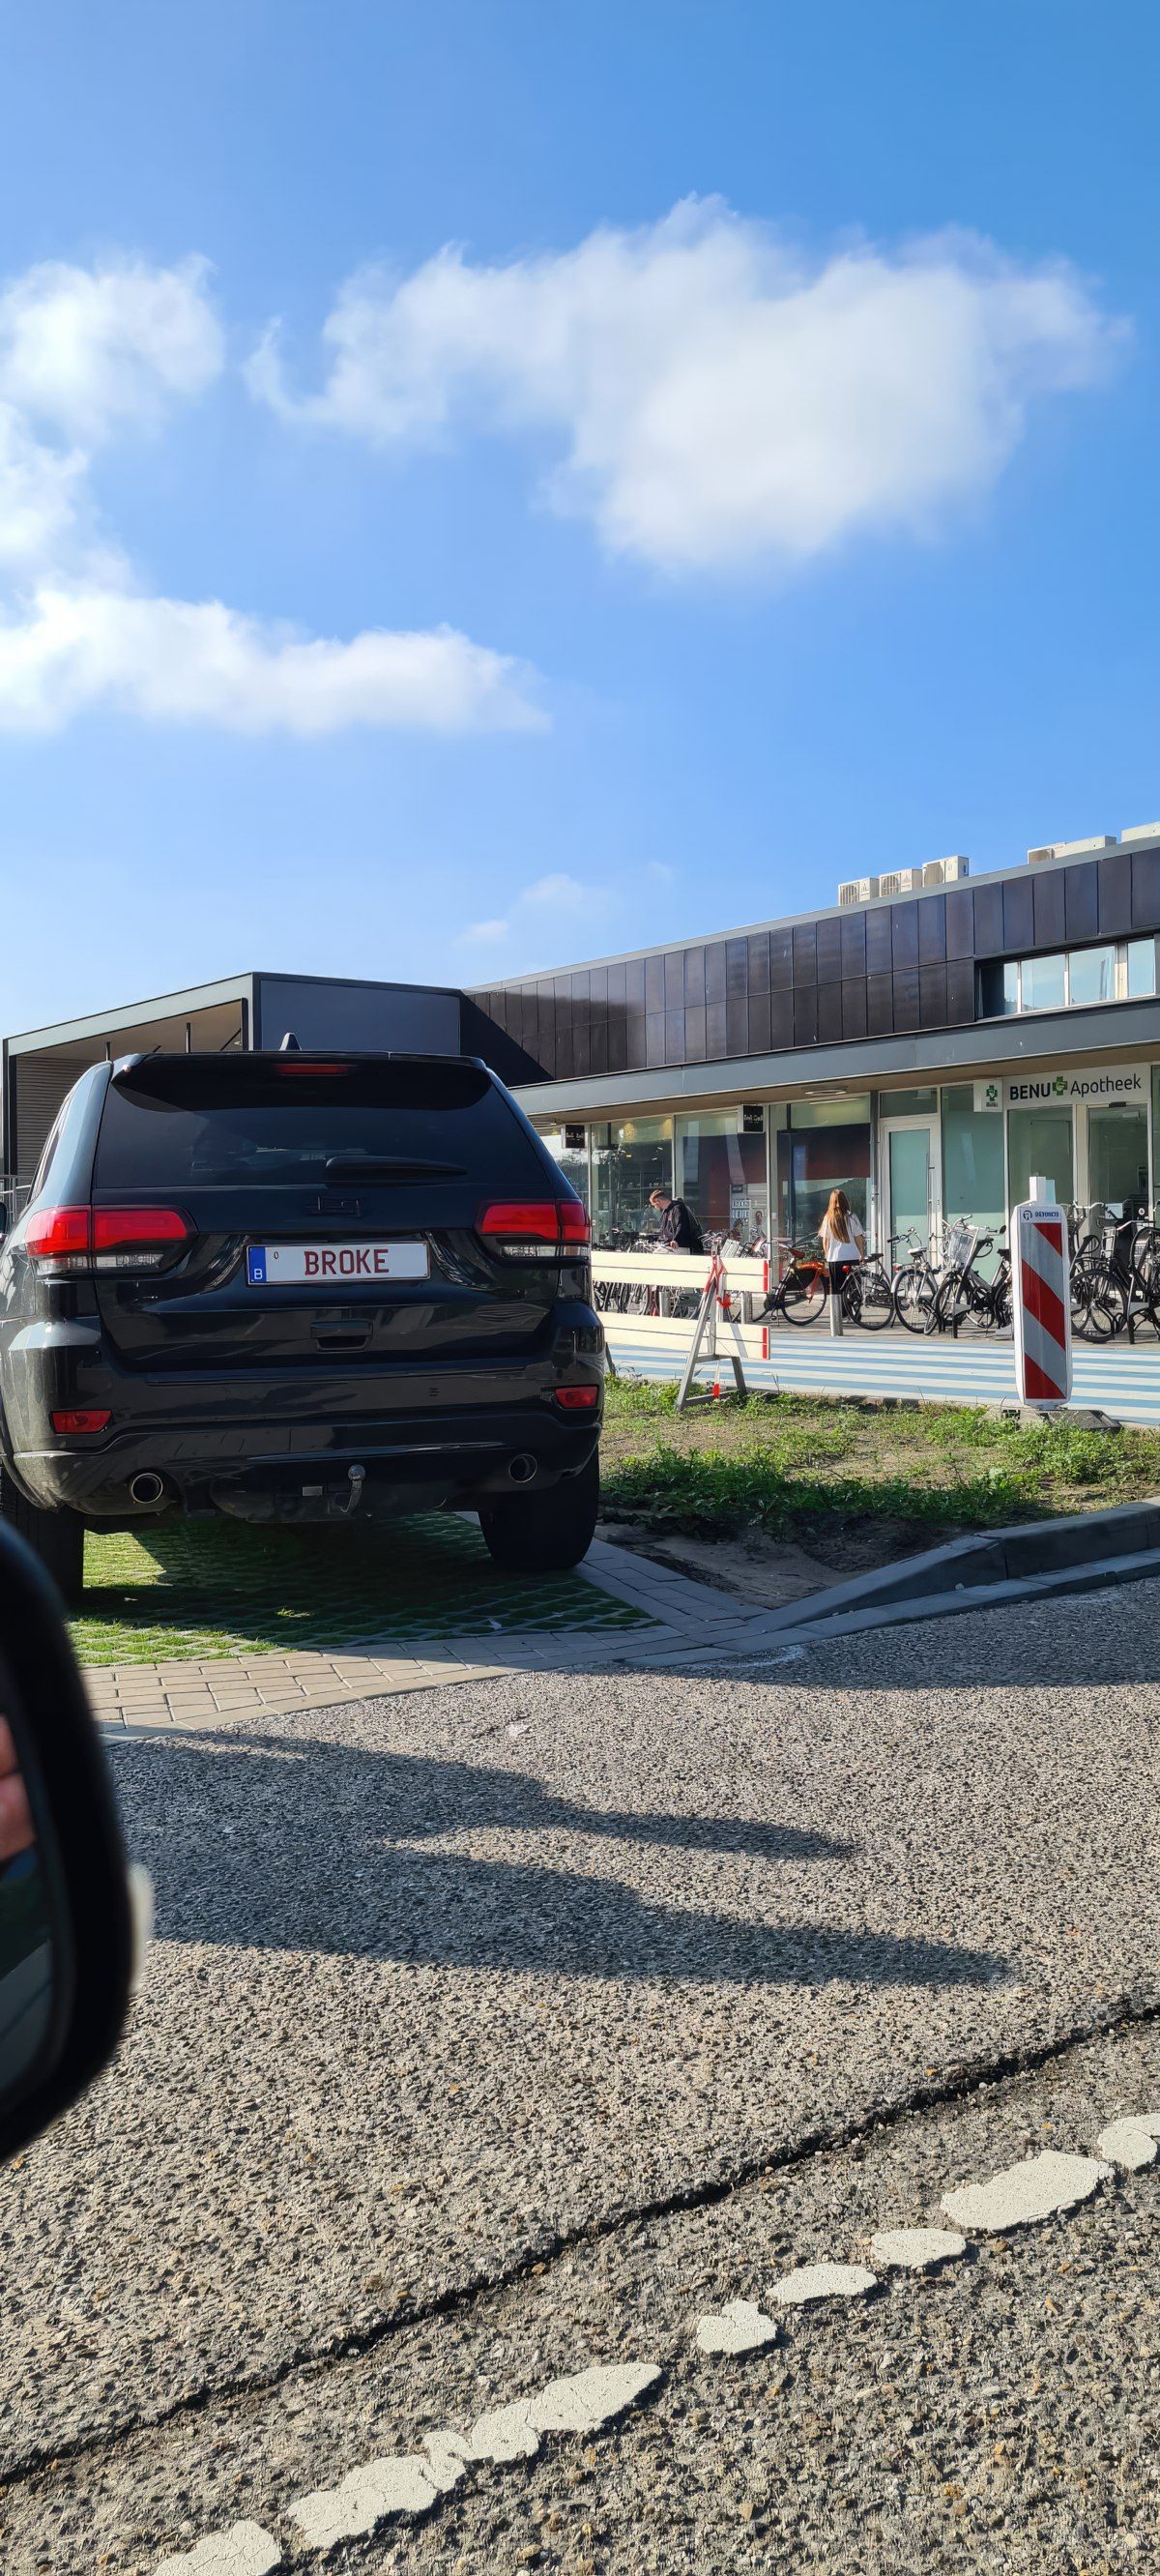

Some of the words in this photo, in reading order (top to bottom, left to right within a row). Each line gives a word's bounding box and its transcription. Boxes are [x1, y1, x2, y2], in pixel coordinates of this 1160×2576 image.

[1009, 1082, 1051, 1100] BENU
[1070, 1073, 1142, 1098] Apotheek
[253, 1268, 263, 1280] B
[304, 1248, 390, 1276] BROKE
